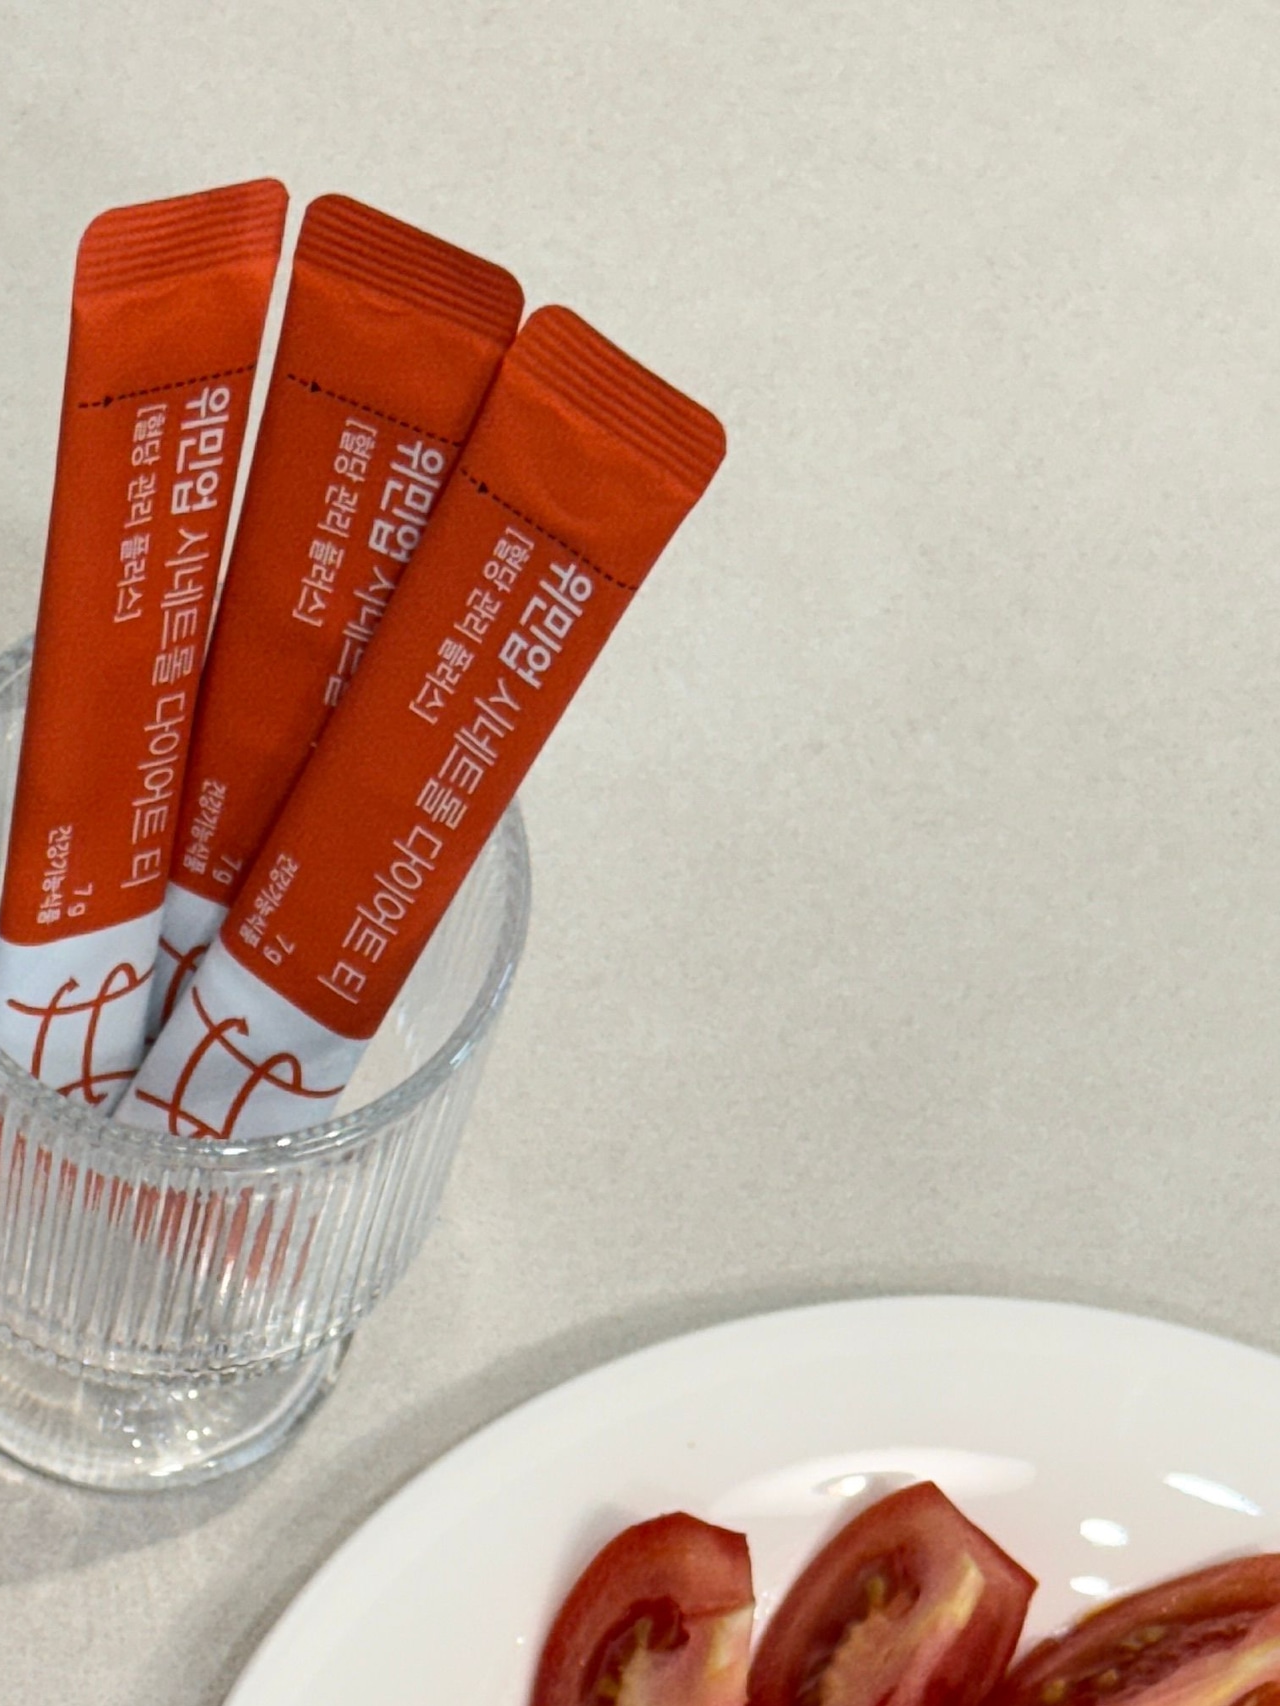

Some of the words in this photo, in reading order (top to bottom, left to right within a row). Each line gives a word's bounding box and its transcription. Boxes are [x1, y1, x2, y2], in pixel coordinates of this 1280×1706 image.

[170, 385, 231, 516] 위민업
[125, 472, 158, 531] 관리
[316, 483, 359, 539] 관리
[368, 440, 447, 565] 위민업
[151, 525, 210, 687] 시네트롤
[452, 587, 504, 645] 관리
[498, 560, 594, 690] 위민업
[131, 690, 186, 846] 다이어트
[416, 676, 521, 831] 시네트롤
[37, 825, 73, 925] 건강기능식품
[121, 848, 161, 889] 티
[183, 779, 227, 875] 건강기능식품
[238, 853, 301, 948] 건강기능식품
[342, 824, 443, 963] 다이어트
[317, 959, 368, 1005] 티
